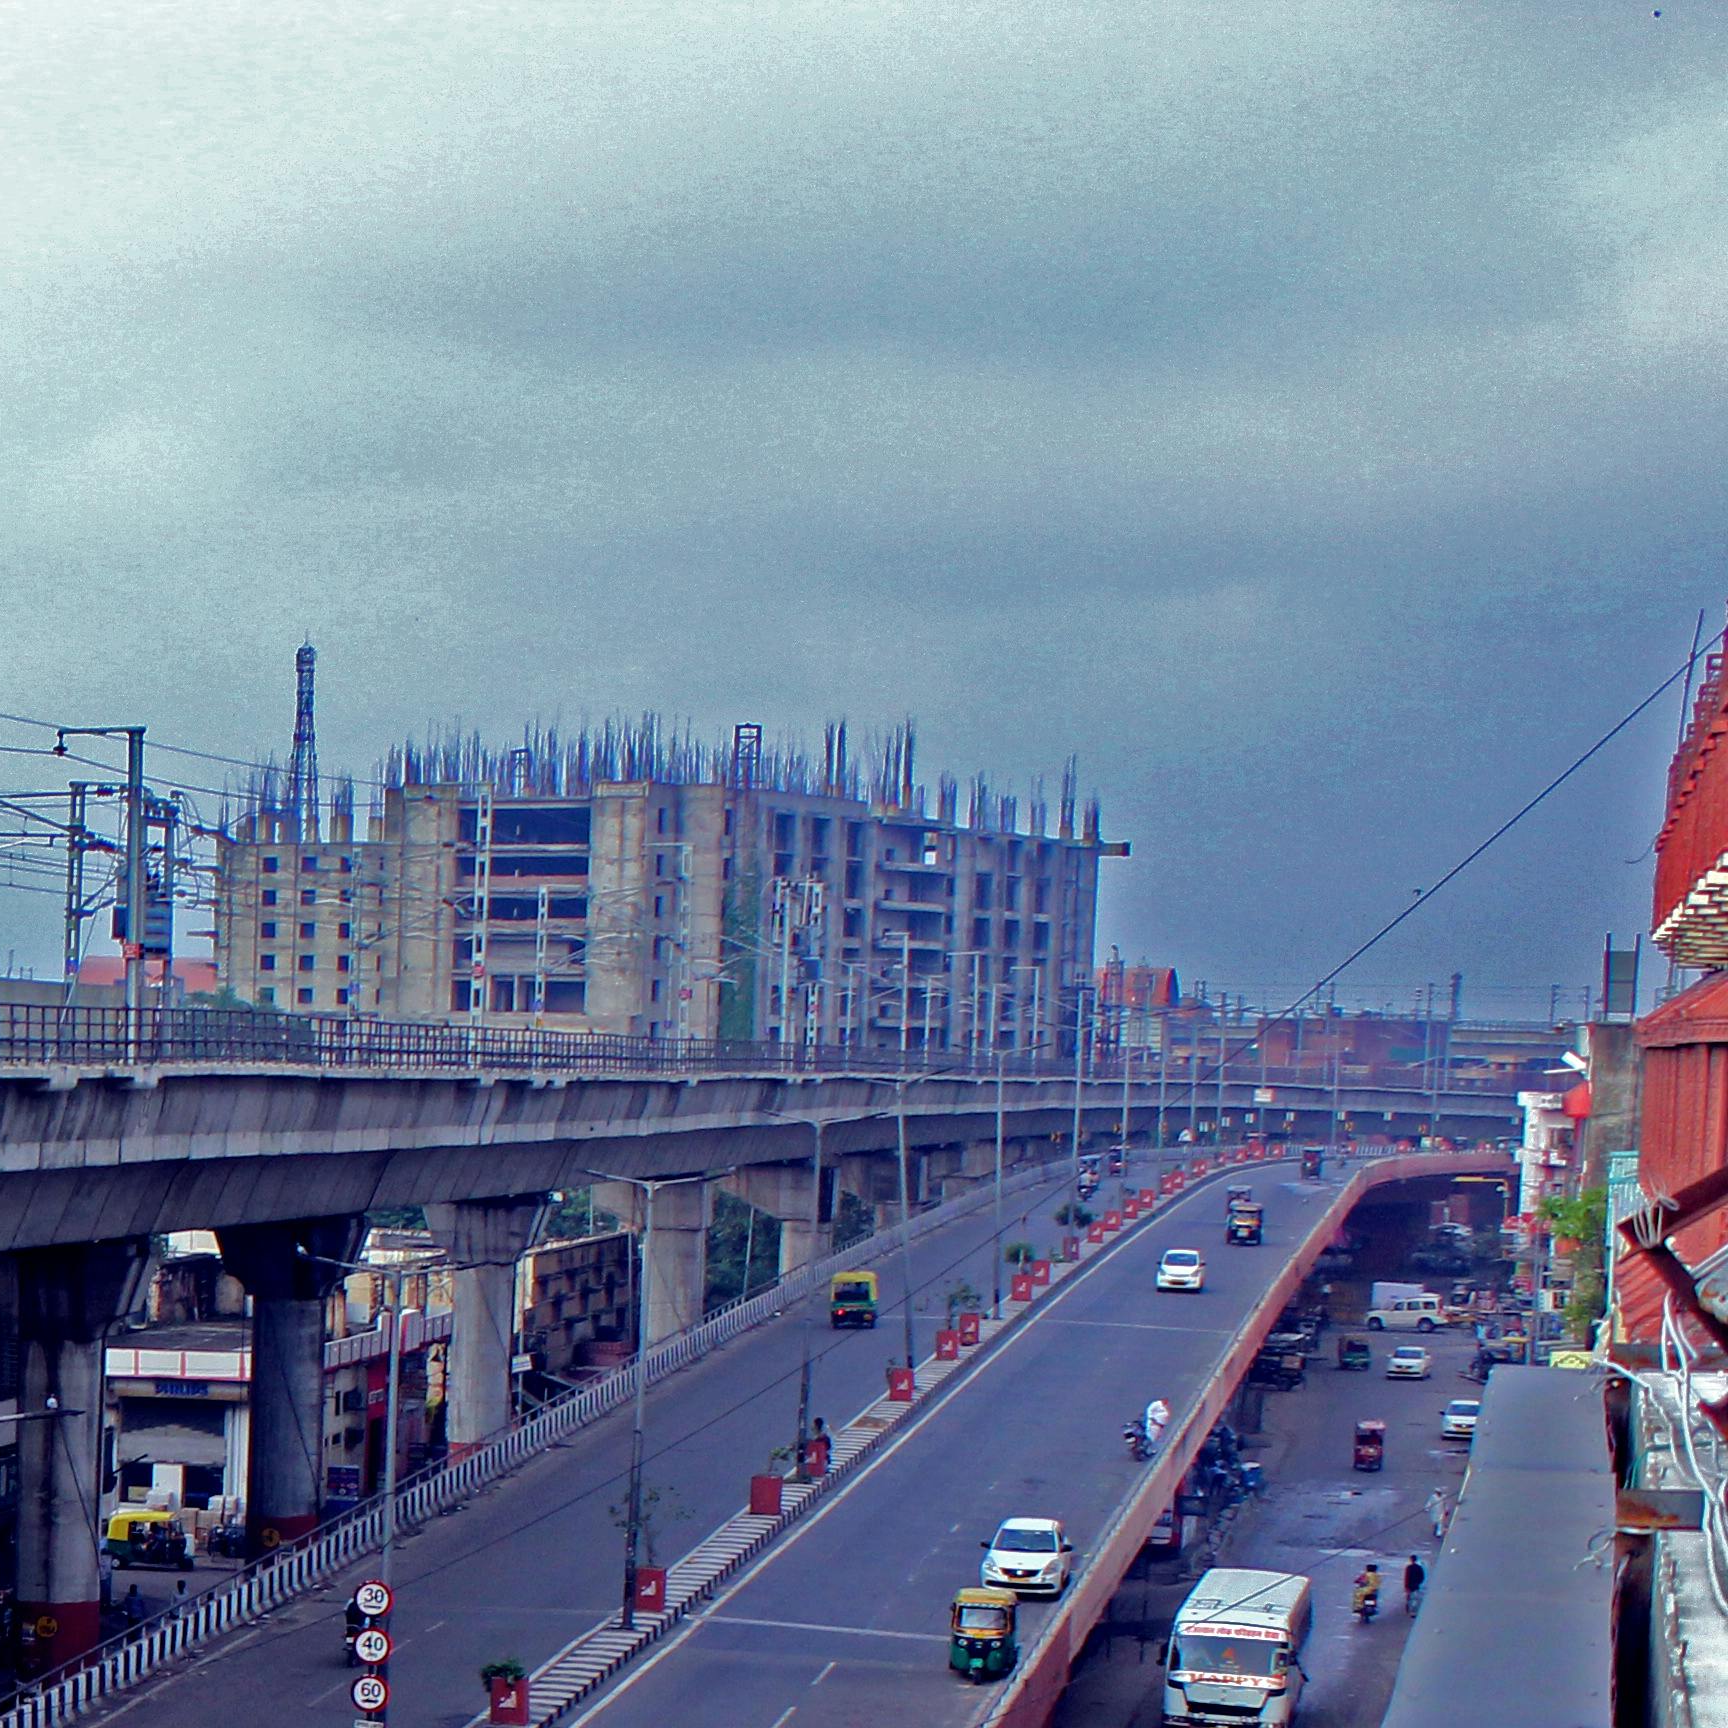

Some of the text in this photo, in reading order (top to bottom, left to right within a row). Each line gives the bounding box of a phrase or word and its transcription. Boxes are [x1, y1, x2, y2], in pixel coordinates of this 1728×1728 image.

[364, 1588, 384, 1603] 30
[362, 1636, 384, 1651] 40
[361, 1682, 381, 1697] 60
